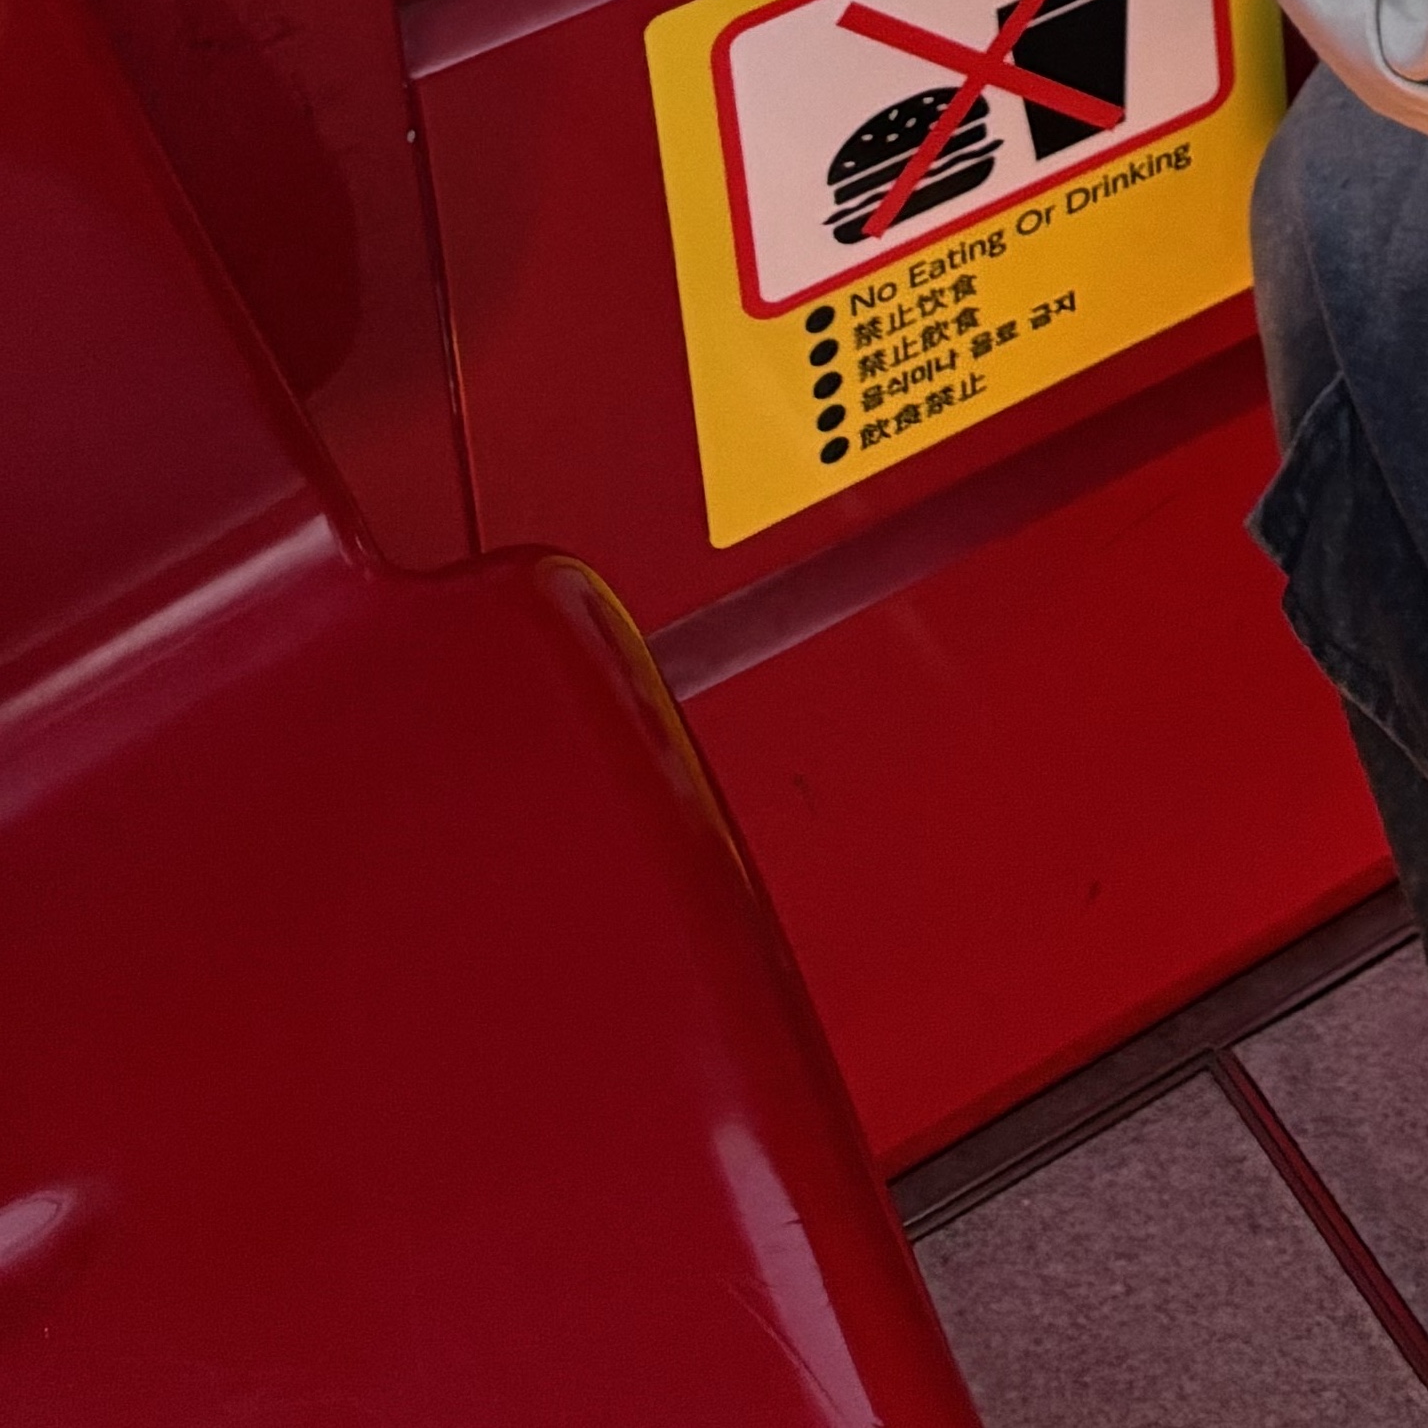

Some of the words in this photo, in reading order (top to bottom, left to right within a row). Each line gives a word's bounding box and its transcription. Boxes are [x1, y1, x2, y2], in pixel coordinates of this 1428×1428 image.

[850, 281, 897, 315] No
[908, 229, 1007, 290] Eating
[1016, 204, 1056, 236] Or
[1065, 142, 1193, 215] Drinking
[853, 274, 977, 349] 禁止饮食
[857, 306, 980, 382] 禁止飲食
[860, 371, 987, 450] 飲食禁止
